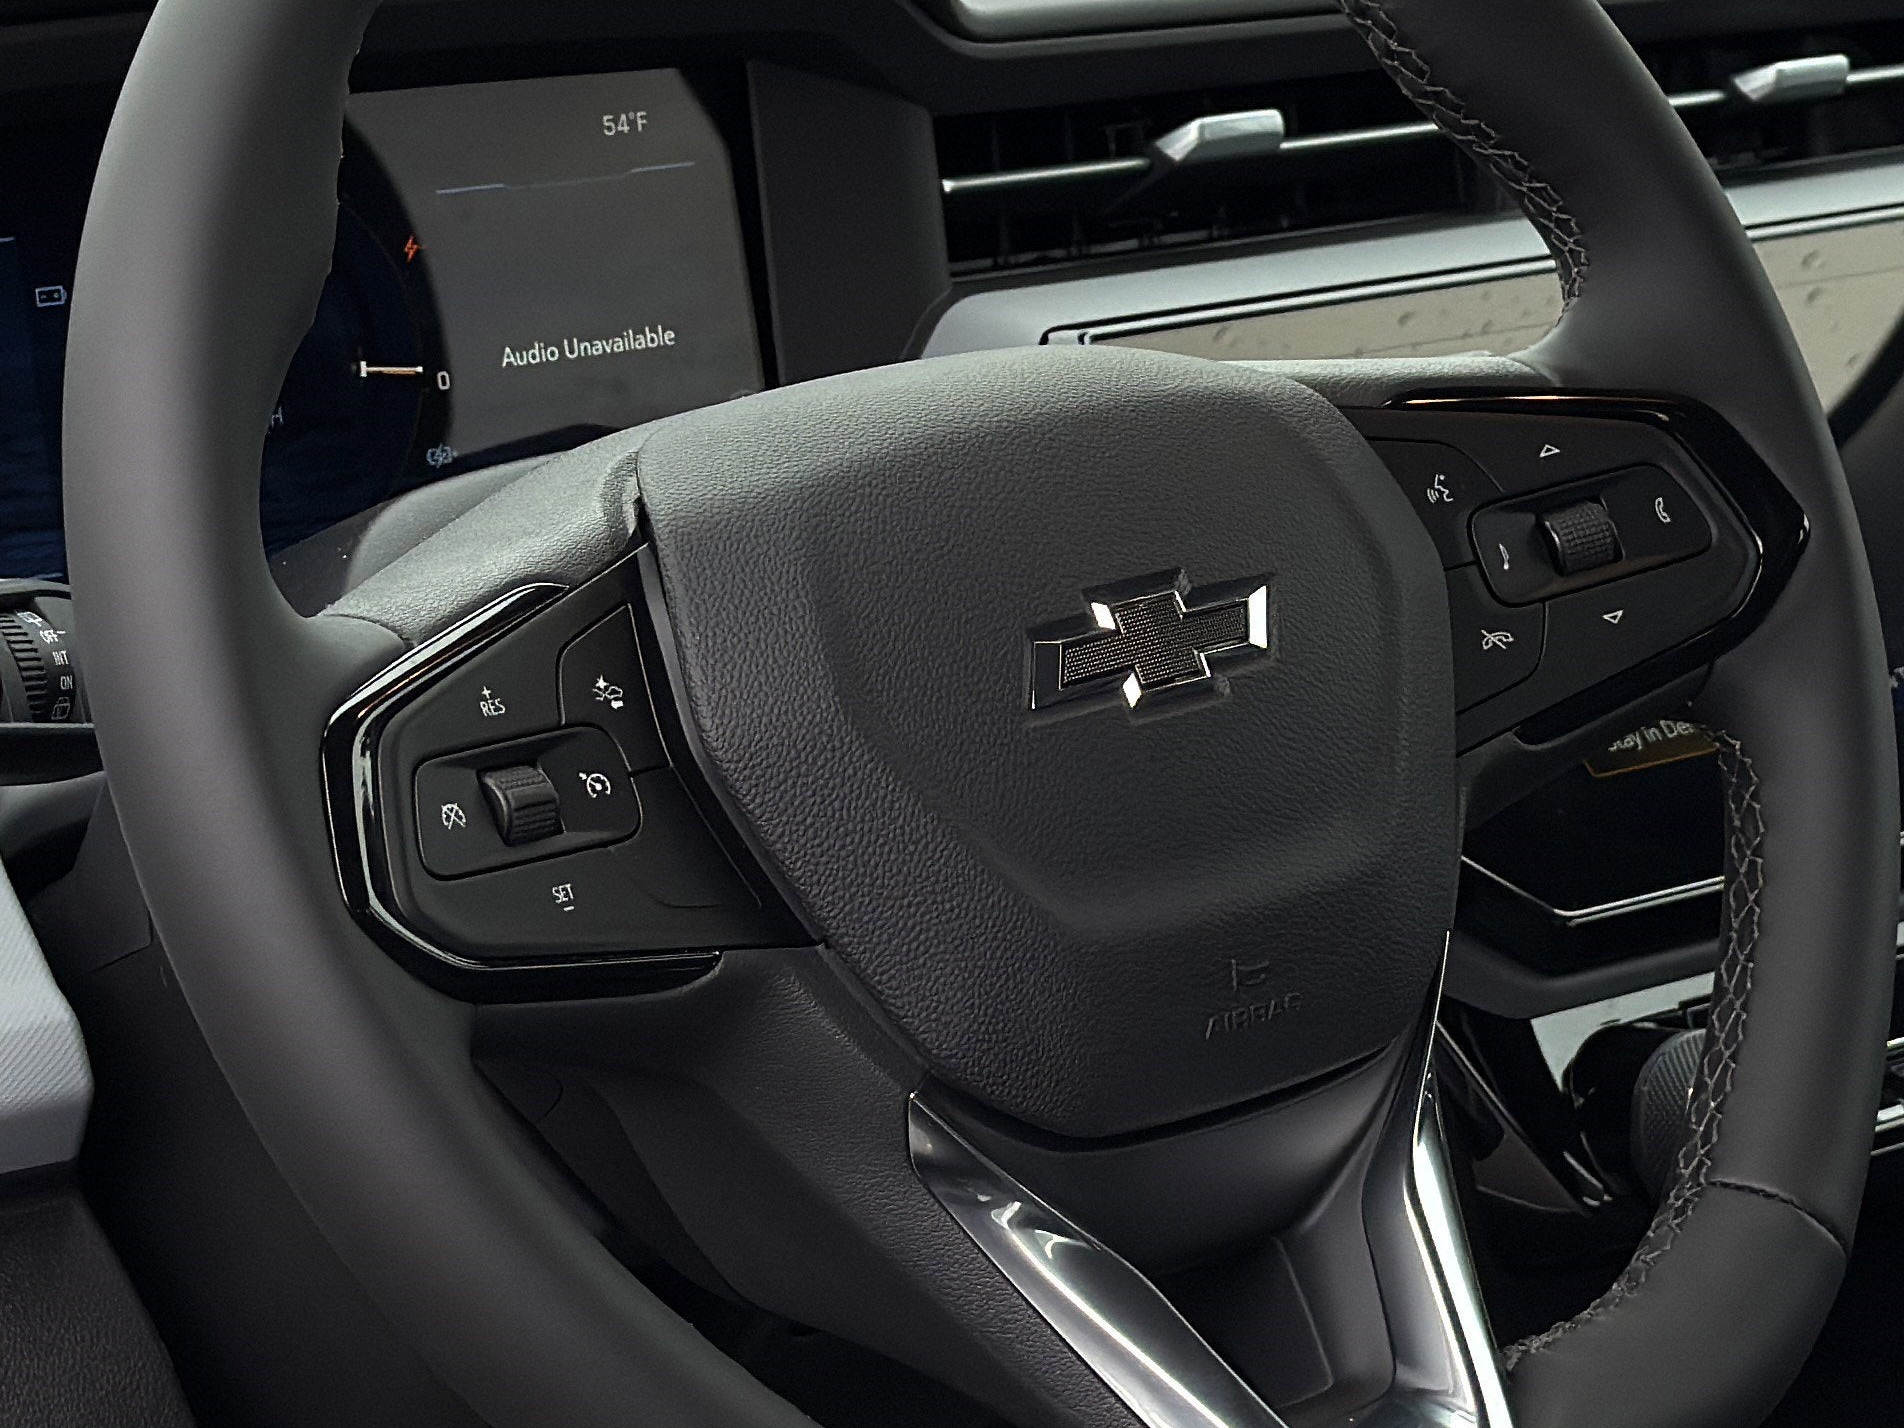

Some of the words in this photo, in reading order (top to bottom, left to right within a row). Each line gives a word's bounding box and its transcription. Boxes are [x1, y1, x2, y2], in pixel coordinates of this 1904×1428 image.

[603, 111, 647, 136] 54°F
[501, 344, 559, 369] Audio
[563, 324, 676, 360] Unavailable
[479, 697, 506, 717] RES
[552, 883, 574, 904] SET
